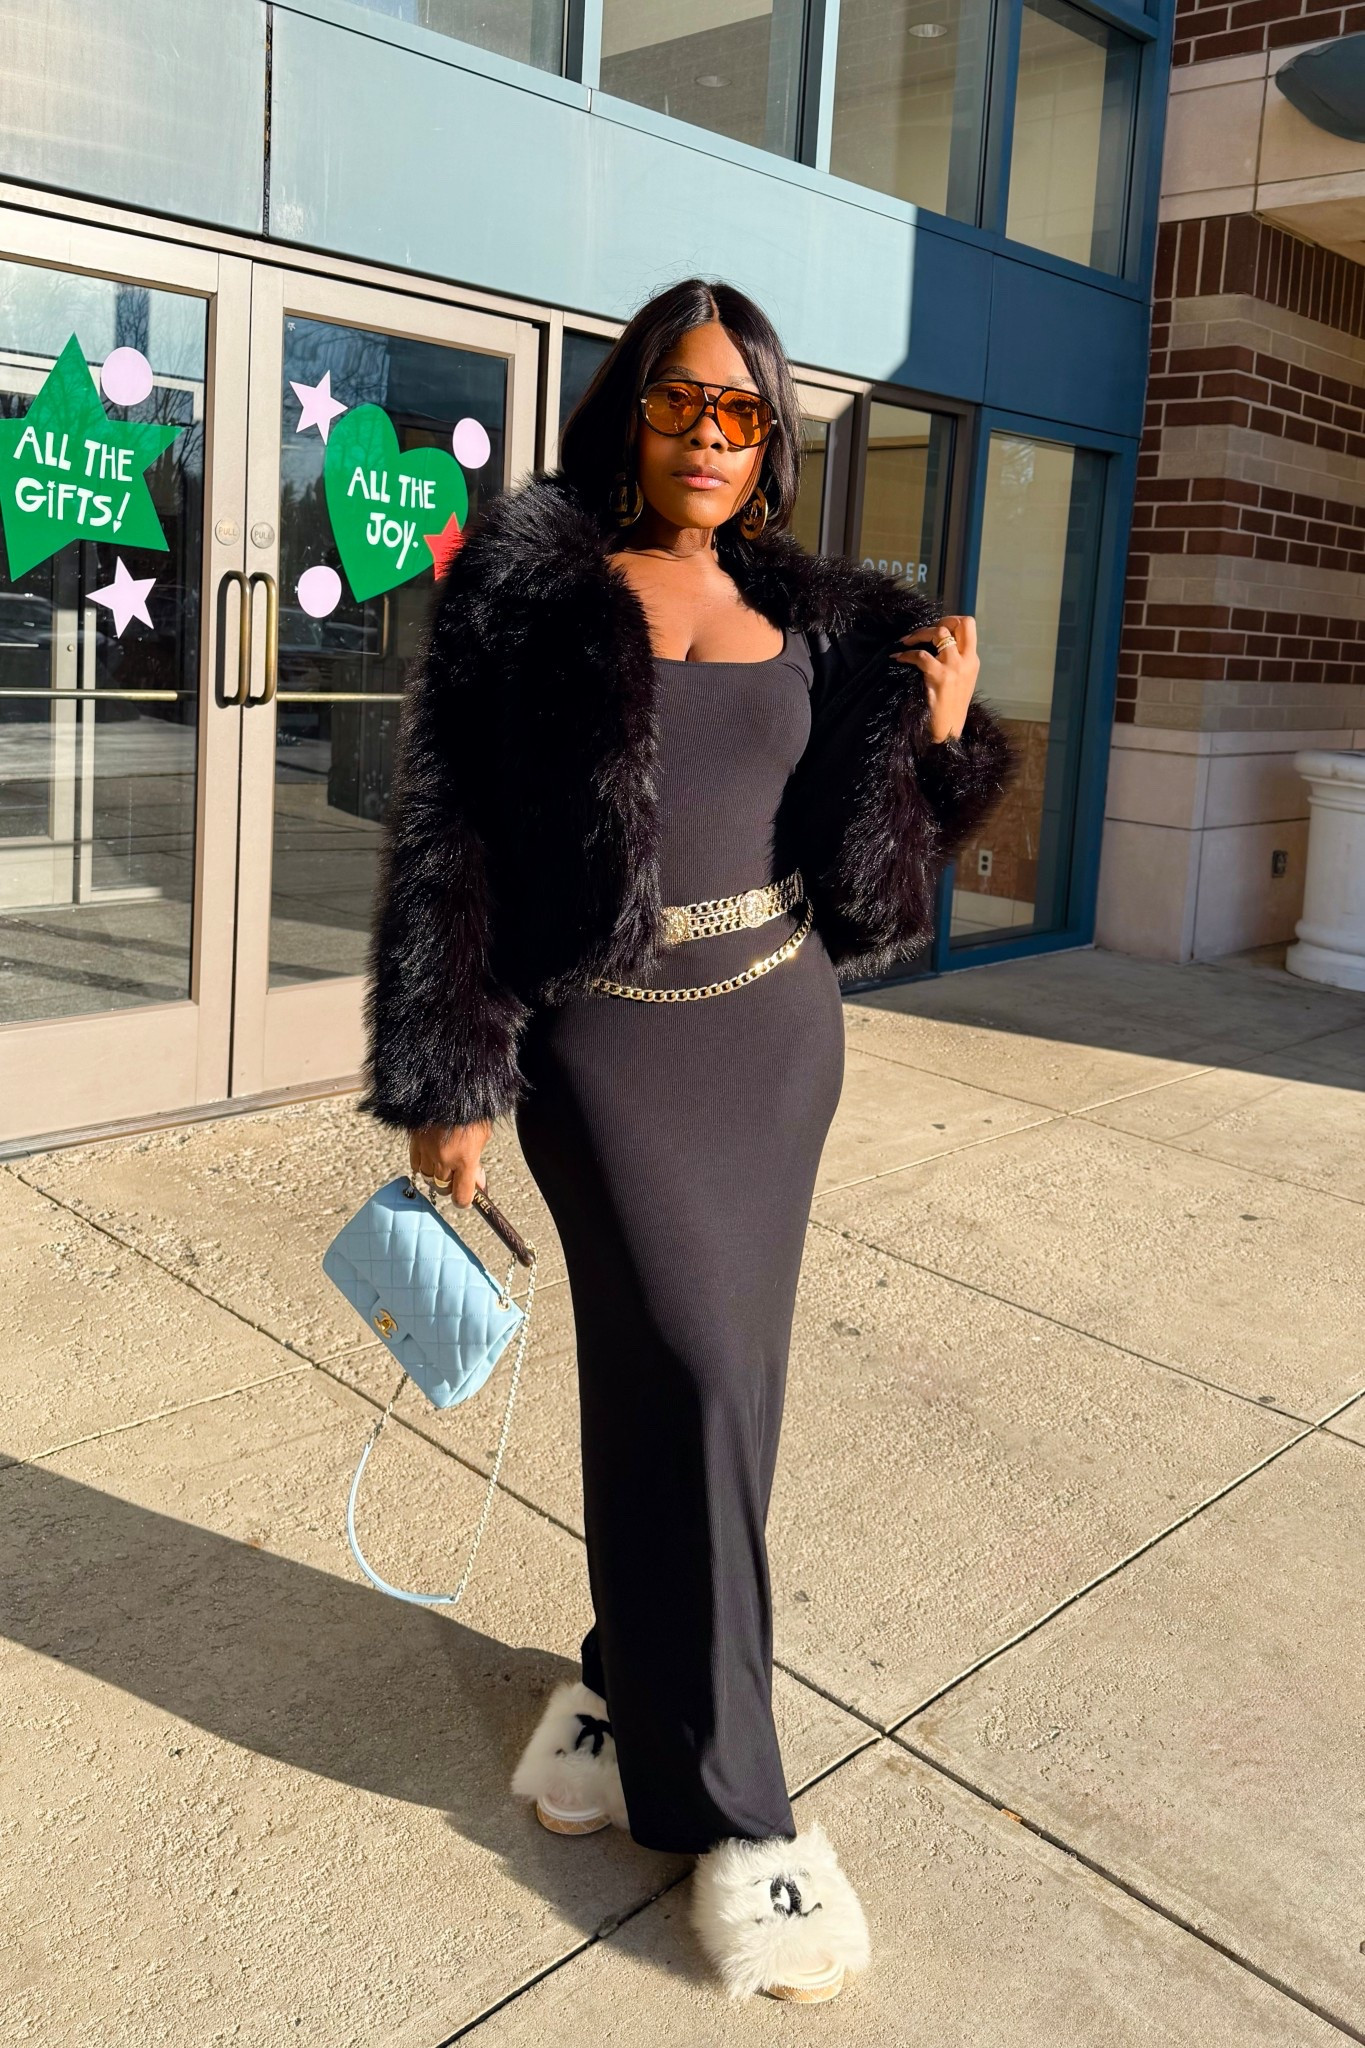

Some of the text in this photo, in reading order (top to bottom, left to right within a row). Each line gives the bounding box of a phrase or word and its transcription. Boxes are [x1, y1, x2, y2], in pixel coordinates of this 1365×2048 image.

[13, 426, 135, 482] ALL THE
[347, 466, 437, 510] ALL THE
[218, 526, 238, 537] PULL
[254, 530, 273, 541] PULL
